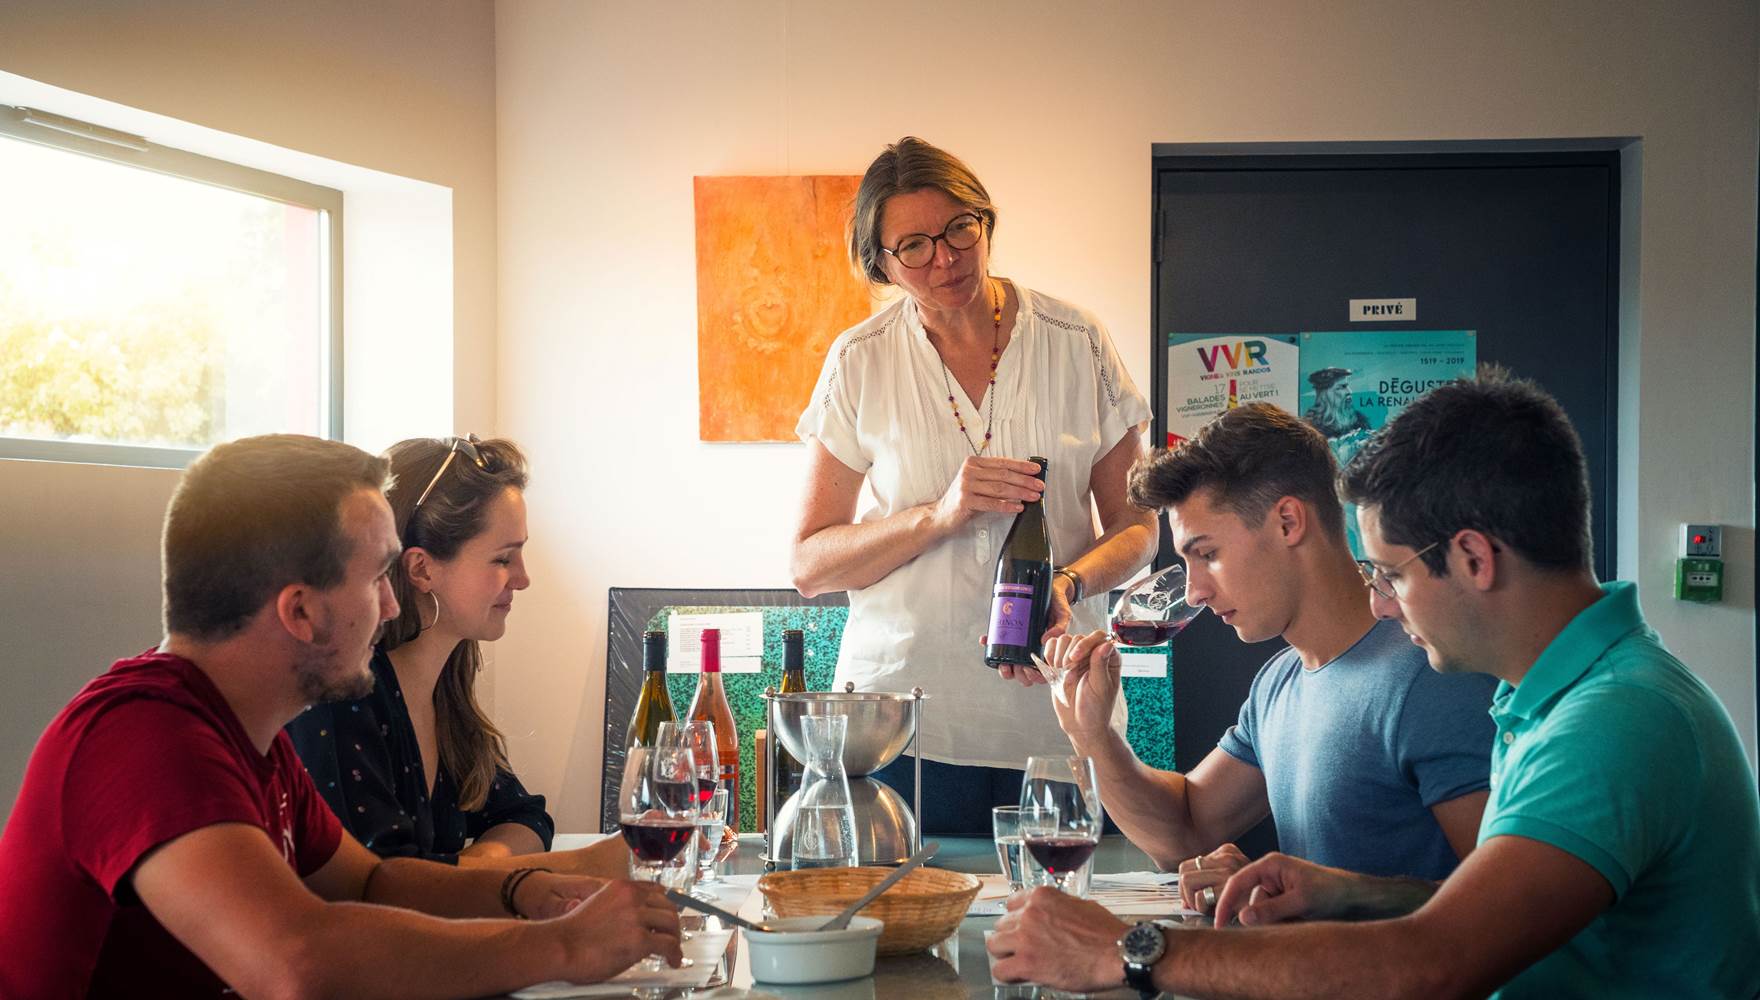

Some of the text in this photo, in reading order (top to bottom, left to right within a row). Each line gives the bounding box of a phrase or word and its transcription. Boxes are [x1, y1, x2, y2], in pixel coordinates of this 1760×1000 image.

[1363, 302, 1403, 315] PRIVÉ
[1197, 340, 1269, 373] VVR
[1420, 357, 1437, 365] 1519
[1446, 357, 1464, 365] 2019
[1215, 383, 1226, 394] 17
[1187, 394, 1226, 405] BALADES
[1240, 393, 1252, 401] AU
[1252, 390, 1274, 399] VERT
[1176, 402, 1224, 413] VIGNERONNES
[1360, 397, 1374, 407] LA
